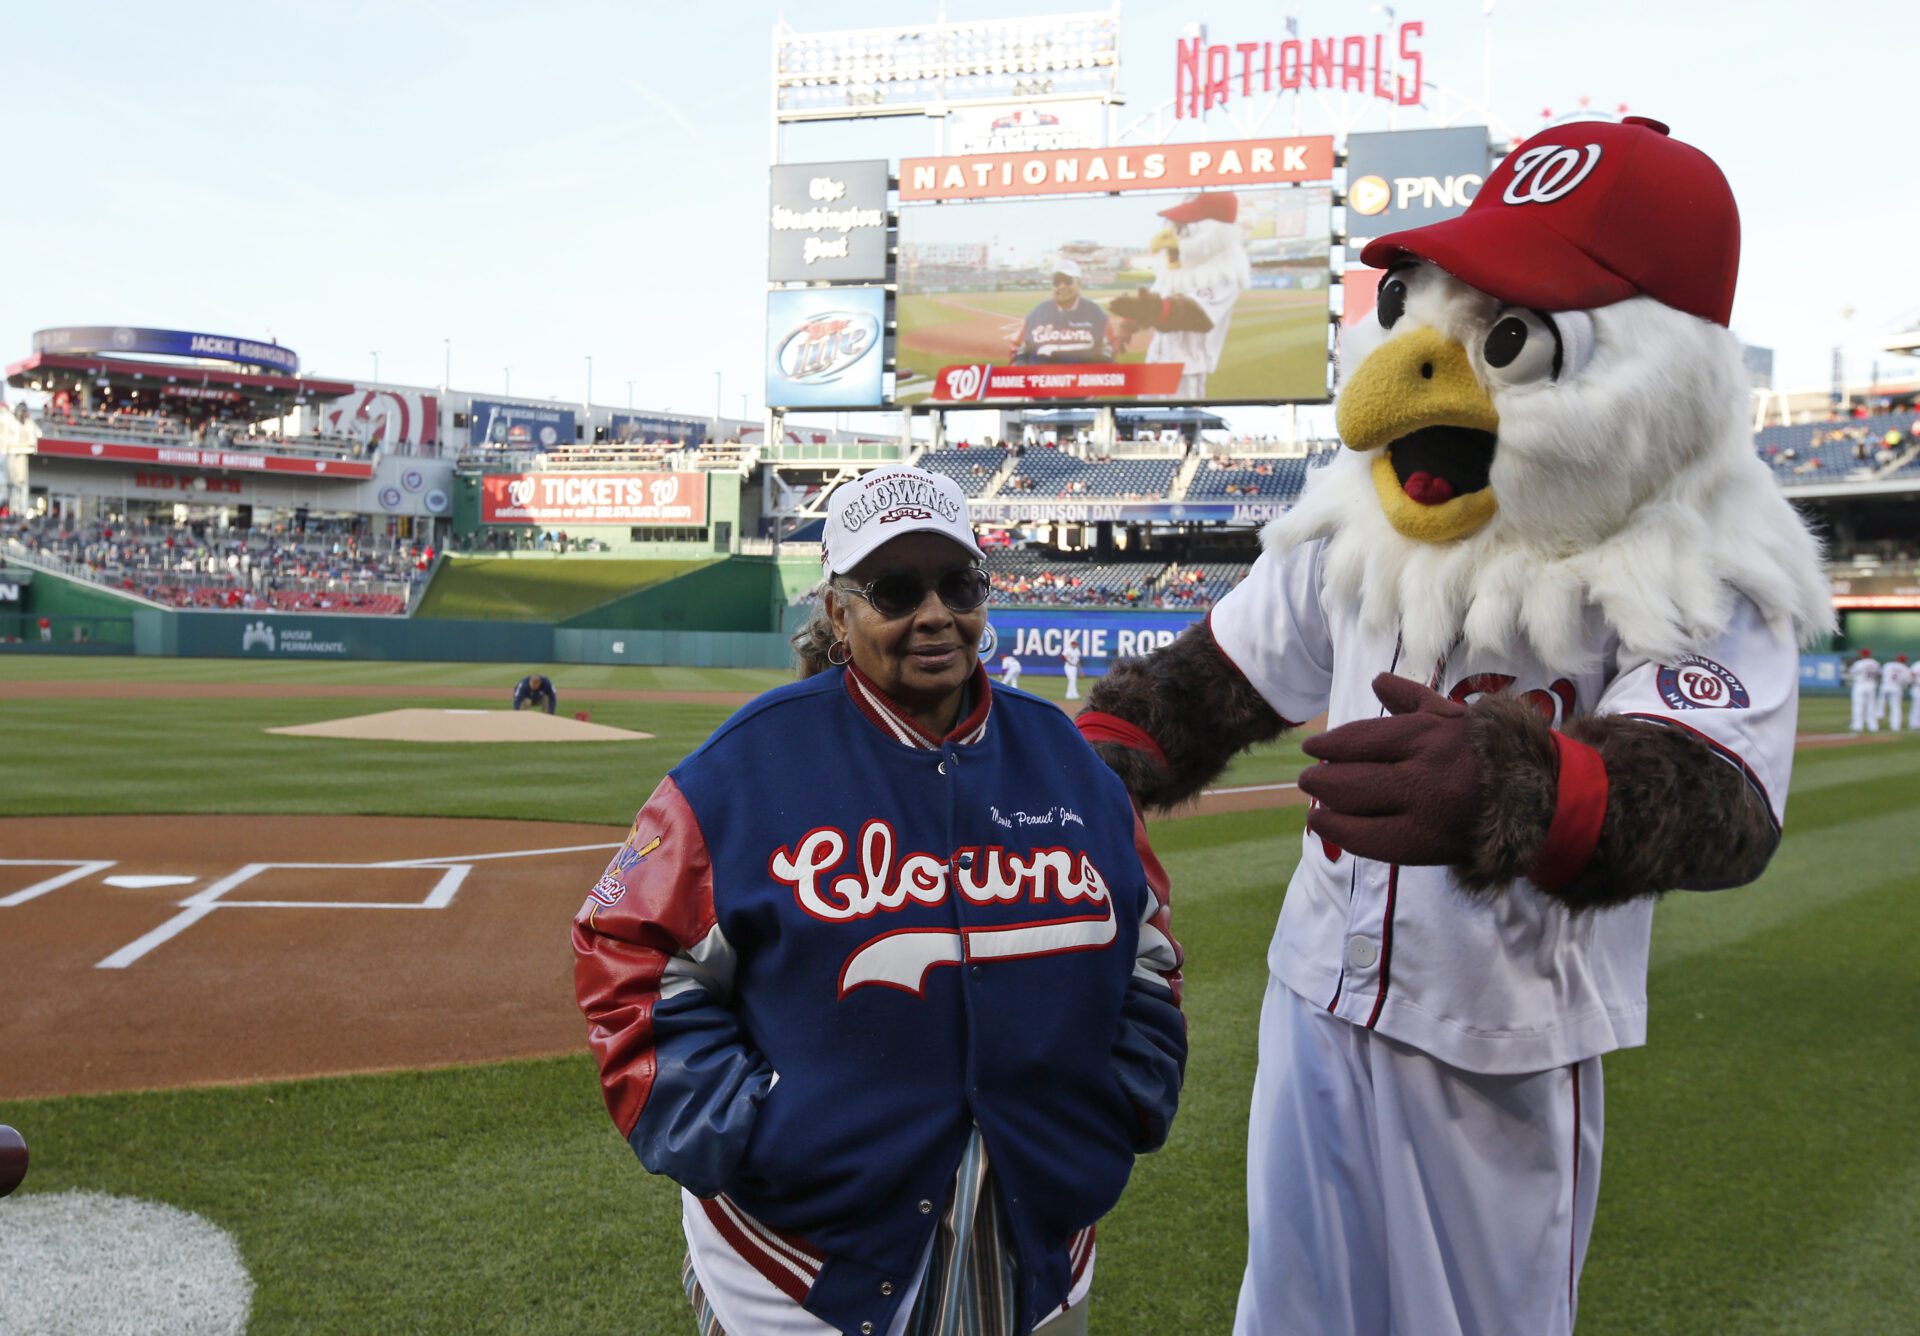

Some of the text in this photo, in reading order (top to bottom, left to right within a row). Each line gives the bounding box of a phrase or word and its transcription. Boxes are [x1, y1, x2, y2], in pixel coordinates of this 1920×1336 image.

[1175, 21, 1424, 120] NATIONALS
[914, 146, 1309, 190] NATIONALS PARK
[1502, 143, 1603, 205] W
[809, 177, 846, 202] The
[1394, 174, 1484, 210] PNC
[772, 204, 884, 233] Washington
[803, 235, 849, 264] Post
[190, 335, 237, 356] JACKIE
[1031, 324, 1094, 343] Clowns
[991, 375, 1025, 389] MAMIE
[1078, 373, 1125, 387] JOHNSON
[541, 478, 643, 505] TICKETS
[864, 474, 934, 489] INDIANAPOLIS
[842, 479, 960, 533] CLOWNS
[1009, 505, 1089, 521] ROBINSON
[1092, 505, 1123, 521] DAY
[1012, 628, 1108, 657] JACKIE
[768, 818, 1113, 923] Clowns
